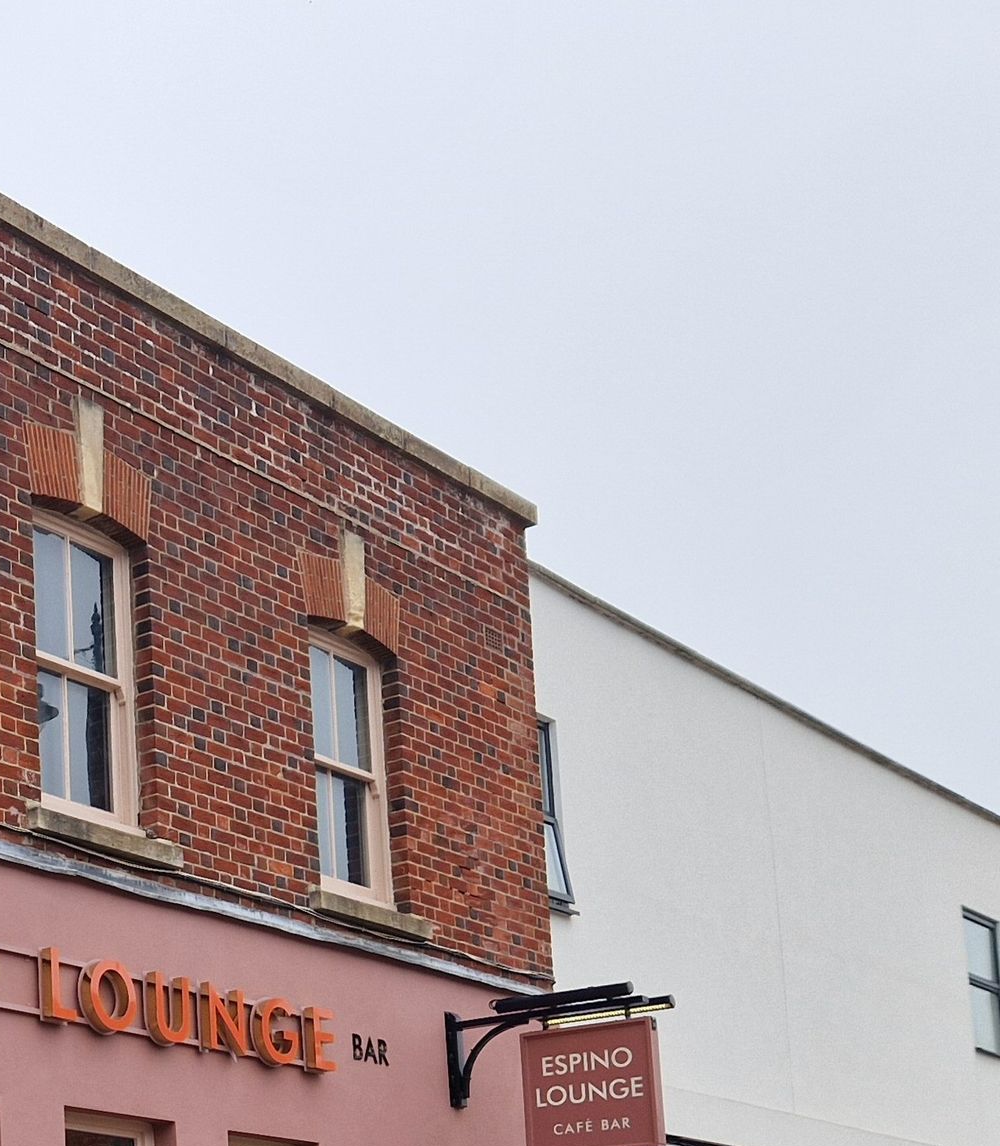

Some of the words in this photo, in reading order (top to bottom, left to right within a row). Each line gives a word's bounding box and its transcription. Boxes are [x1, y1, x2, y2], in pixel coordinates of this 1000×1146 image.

[39, 946, 337, 1074] LOUNGE
[352, 1033, 389, 1067] BAR
[541, 1047, 633, 1077] ESPINO
[536, 1076, 644, 1108] LOUNGE
[553, 1118, 593, 1136] CAFÉ
[601, 1117, 631, 1131] BAR
